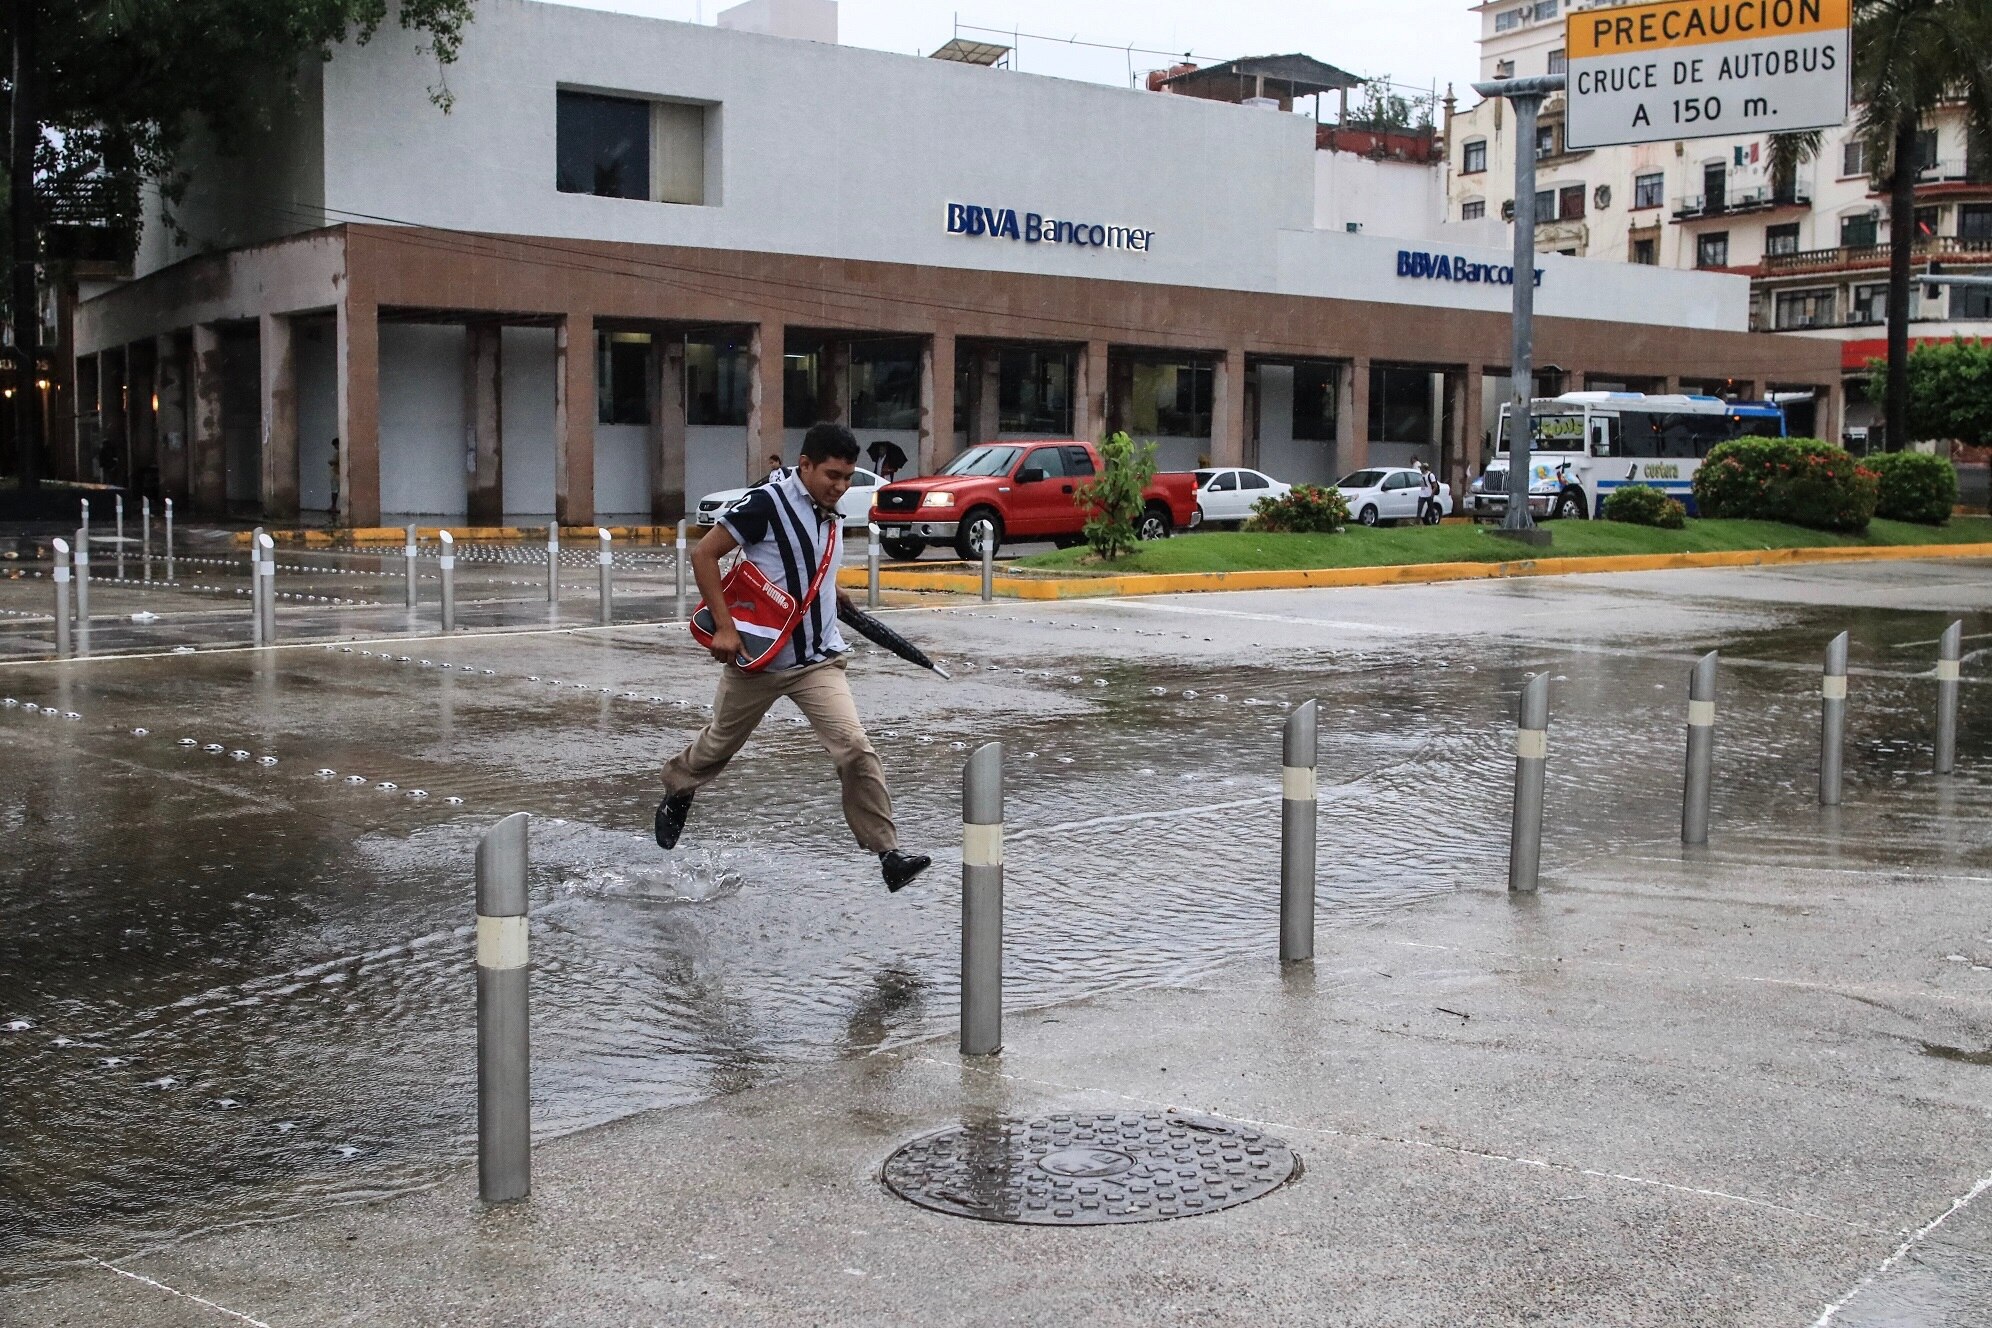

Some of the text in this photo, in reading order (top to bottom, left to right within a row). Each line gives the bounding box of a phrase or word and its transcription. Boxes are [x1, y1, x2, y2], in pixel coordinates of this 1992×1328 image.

[1578, 45, 1836, 95] CRUCE DE AUTOBUS
[1632, 96, 1779, 128] A 150 m.
[947, 202, 1155, 252] BBVA Bancomer
[1397, 250, 1545, 287] BBVA Bancor
